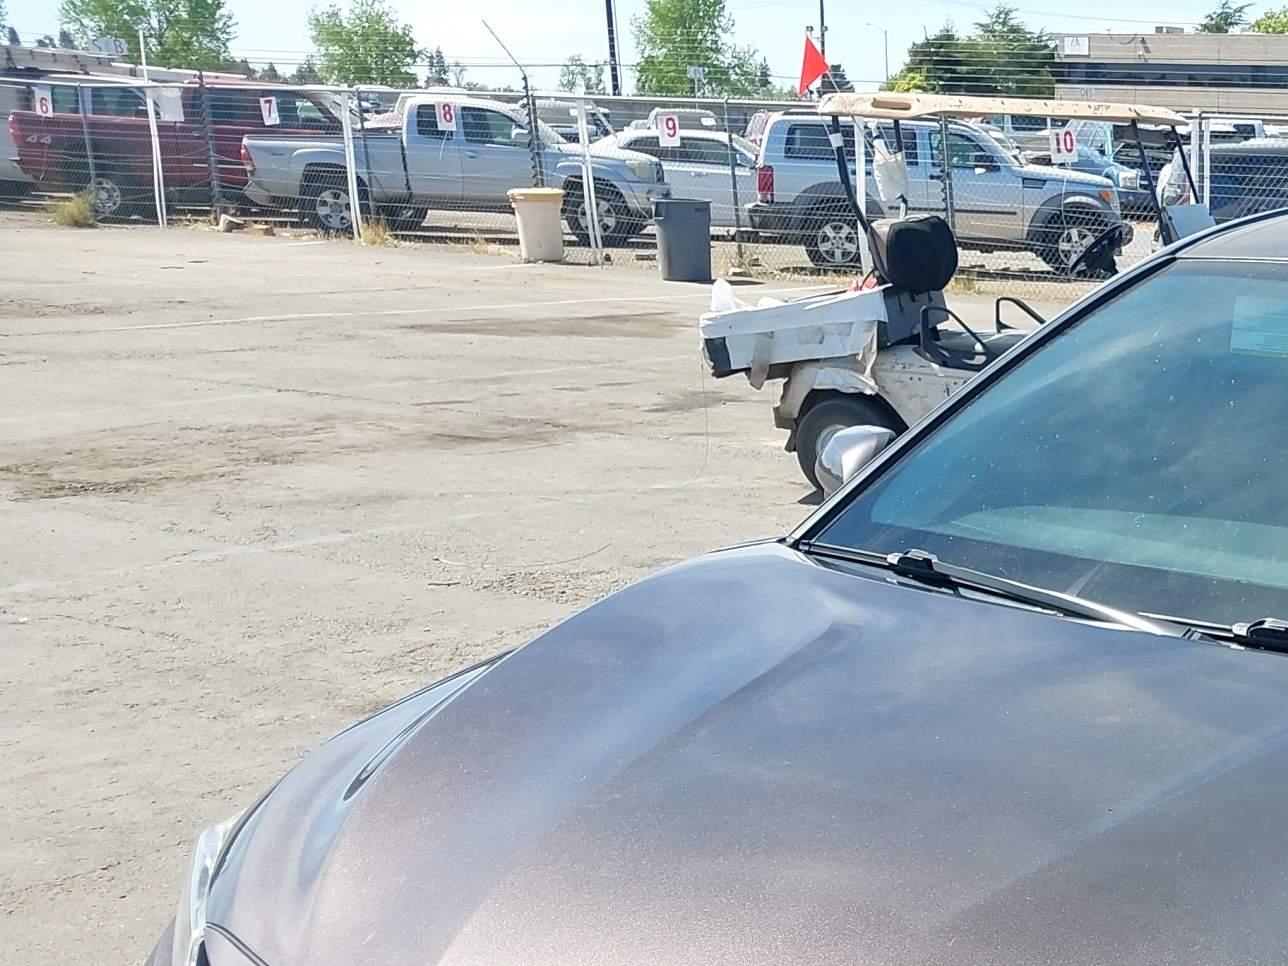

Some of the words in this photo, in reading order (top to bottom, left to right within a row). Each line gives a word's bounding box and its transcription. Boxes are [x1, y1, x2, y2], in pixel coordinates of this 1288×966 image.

[40, 96, 49, 114] 6
[262, 99, 275, 118] 7
[441, 103, 452, 123] 8
[665, 117, 677, 138] 9
[1054, 130, 1074, 154] 10
